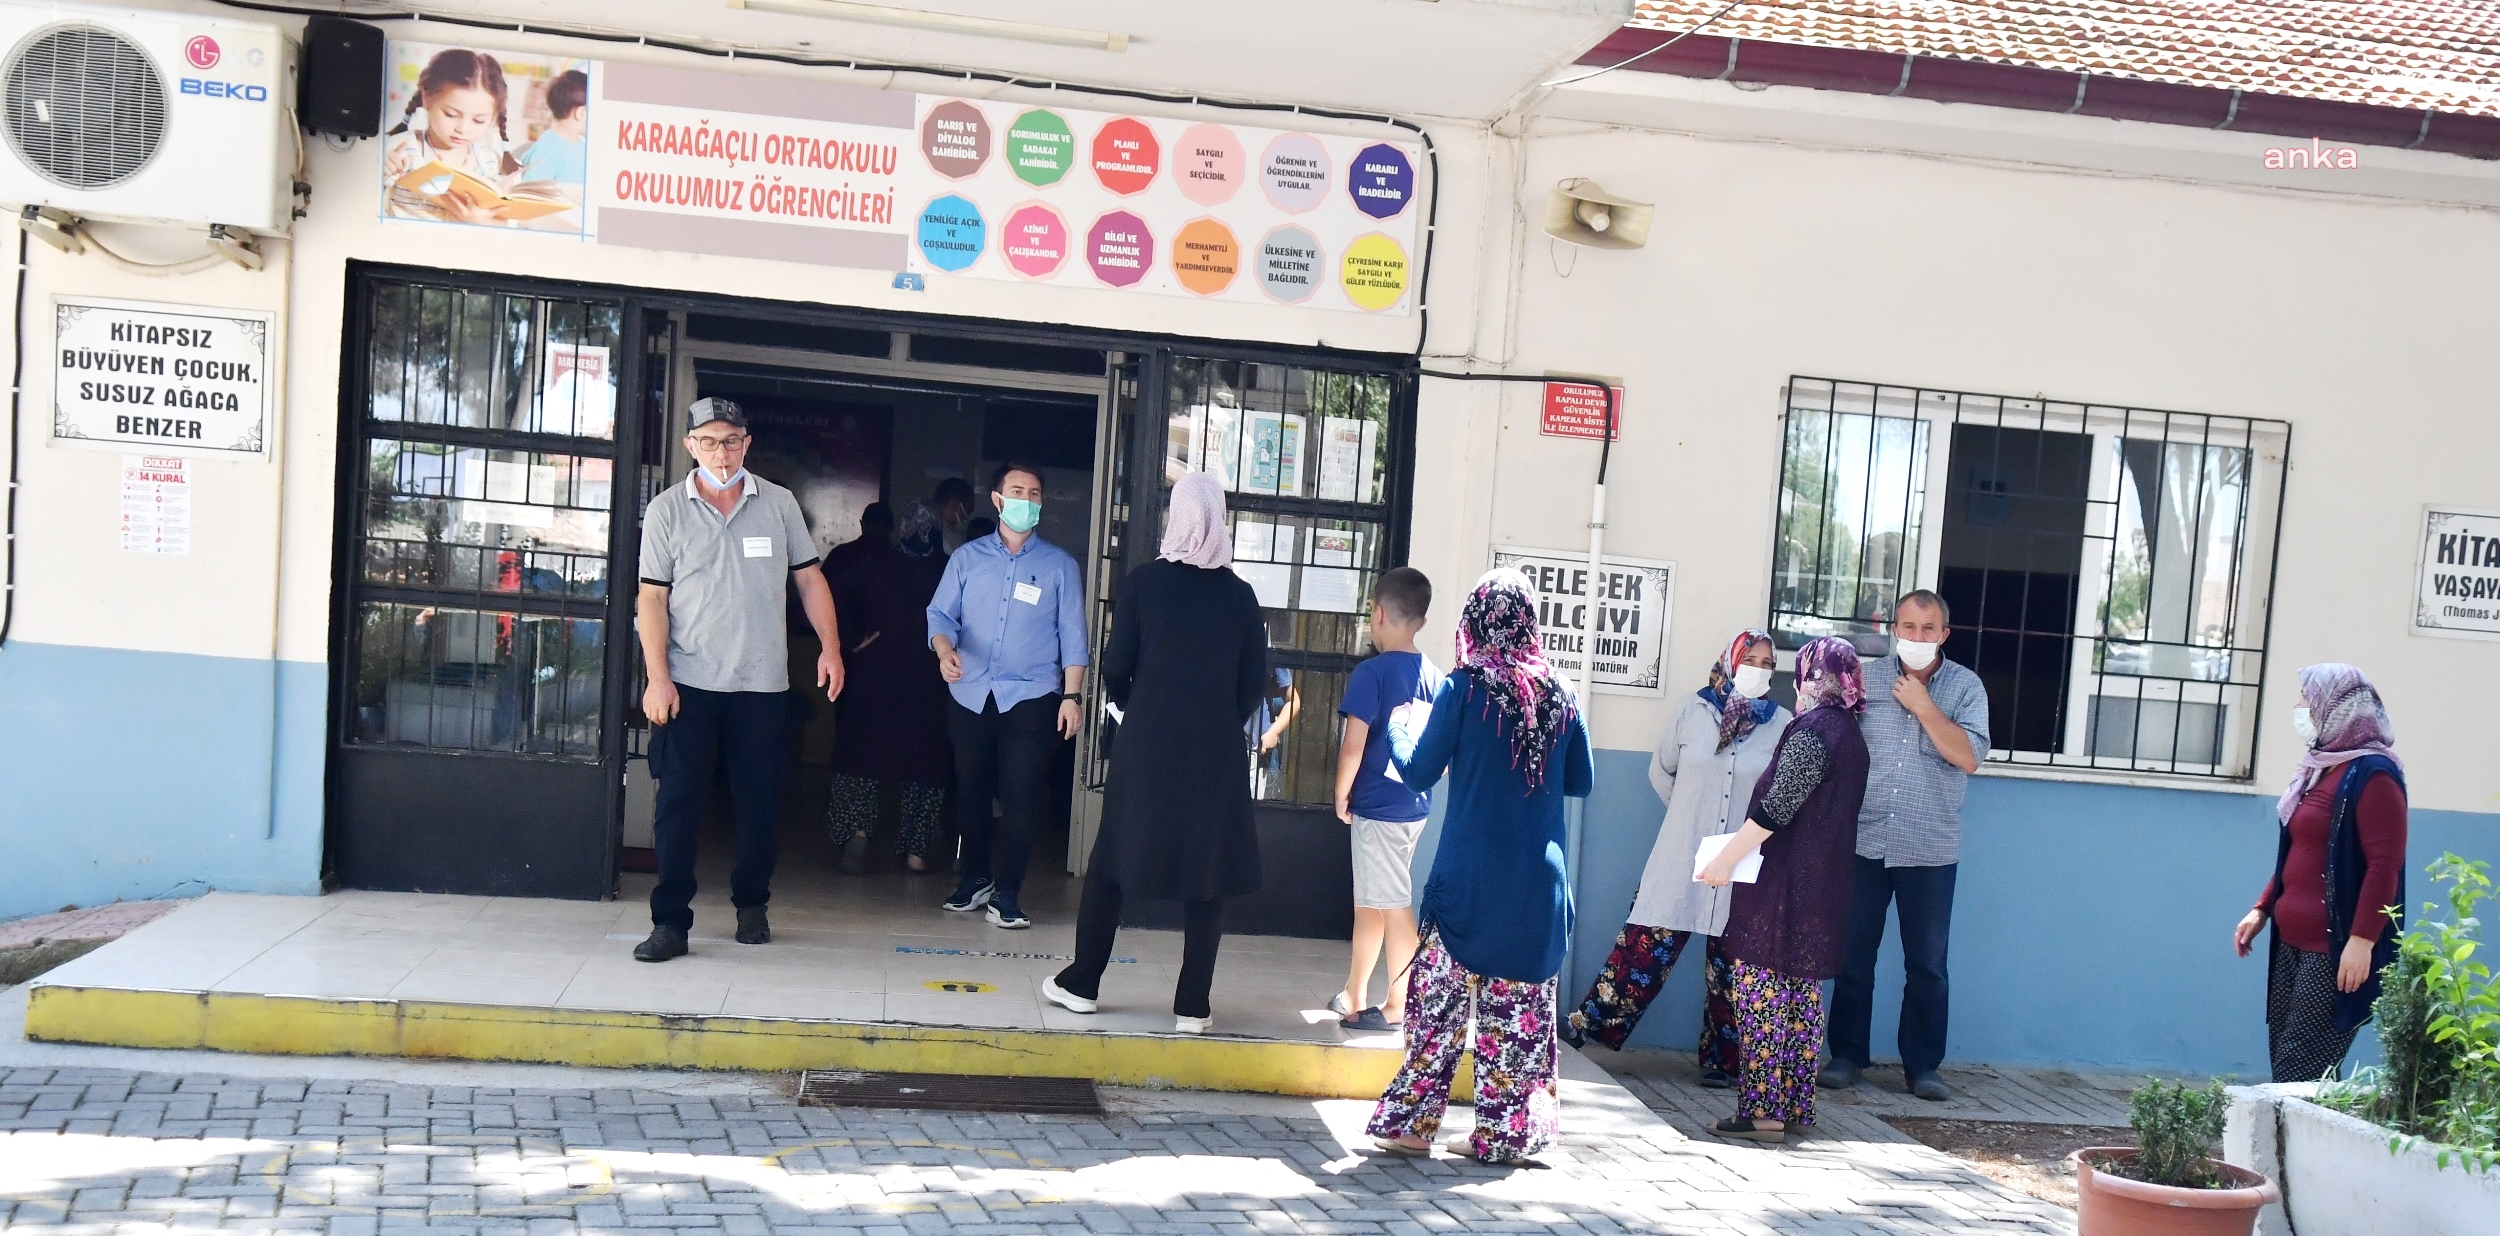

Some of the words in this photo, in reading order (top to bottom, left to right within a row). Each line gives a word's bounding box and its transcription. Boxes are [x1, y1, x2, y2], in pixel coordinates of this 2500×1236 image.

[180, 78, 267, 102] BEKO
[937, 119, 964, 133] BARIŞ
[966, 122, 977, 132] VE
[937, 131, 976, 146] DİYALOG
[1011, 129, 1060, 142] SORUMLULUK
[1061, 134, 1071, 143] VE
[618, 119, 758, 168] KARAAĞAÇLI
[764, 134, 897, 176] ORTAOKULU
[1023, 144, 1058, 156] SADAKAT
[1113, 139, 1139, 150] PLANLI
[932, 146, 980, 160] SAHİBİDİR.
[1121, 152, 1131, 161] VE
[1195, 148, 1223, 158] SAYGILI
[1019, 157, 1059, 169] SAHİBİDİR.
[1096, 161, 1154, 174] PROGRAMLIDIR.
[1204, 160, 1213, 168] VE
[1275, 155, 1307, 167] ÖĞRENİR
[1309, 160, 1317, 168] VE
[1190, 170, 1227, 181] SEÇİCİDİR.
[1266, 166, 1325, 180] ÖĞRENDİKLERİNİ
[1365, 163, 1399, 175] KARARLI
[1278, 180, 1312, 190] UYGULAR.
[1376, 176, 1386, 186] VE
[616, 169, 744, 211] OKULUMUZ
[750, 174, 894, 225] ÖĞRENCİLERİ
[1358, 185, 1401, 199] İRADELİDİR
[924, 214, 958, 225] YENİLİĞE
[961, 218, 980, 229] AÇIK
[947, 229, 956, 237] VE
[1023, 223, 1048, 235] AZİMLİ
[1030, 236, 1040, 245] VE
[1104, 230, 1125, 242] BİLGİ
[1127, 234, 1137, 243] VE
[923, 240, 978, 251] COŞKULUDUR.
[1008, 246, 1059, 258] ÇALIŞKANDIR.
[1100, 244, 1140, 256] UZMANLIK
[1185, 242, 1228, 252] MERHAMETLİ
[1265, 244, 1303, 258] ÜLKESİNE
[1305, 250, 1316, 259] VE
[1098, 255, 1140, 269] SAHİBİDİR.
[1175, 262, 1235, 274] YARDIMSEVERDİR.
[1269, 258, 1310, 271] MİLLETİNE
[1347, 257, 1382, 266] ÇEVRESİNE
[1383, 260, 1404, 270] KARŞI
[1268, 272, 1309, 285] BAĞLIDIR.
[1357, 268, 1383, 277] SAYGILI
[903, 277, 913, 290] 5
[1346, 277, 1366, 286] GÜLER
[1368, 279, 1402, 289] YÜZLÜDÜR.
[110, 319, 212, 348] KİTAPSIZ
[62, 346, 164, 375] BÜYÜYEN
[80, 381, 155, 405] SUSUZ
[164, 385, 239, 412] AĞACA
[1563, 387, 1604, 397] OKULUMUZ
[1555, 396, 1582, 405] KAPALI
[1585, 399, 1607, 407] DEVR
[1563, 405, 1601, 416] GÜVENLİK
[116, 415, 202, 440] BENZER
[1550, 415, 1582, 424] KAMERA
[1583, 416, 1612, 427] SİSTEİ
[1544, 421, 1556, 431] İLE
[1558, 423, 1617, 436] İZLENMEKTEİR
[144, 457, 182, 469] DİKKAT
[139, 471, 149, 481] 14
[152, 473, 186, 484] KURAL
[1538, 596, 1641, 635] İLGİYİ
[2443, 605, 2489, 620] (Thomas
[1558, 658, 1582, 671] Kema
